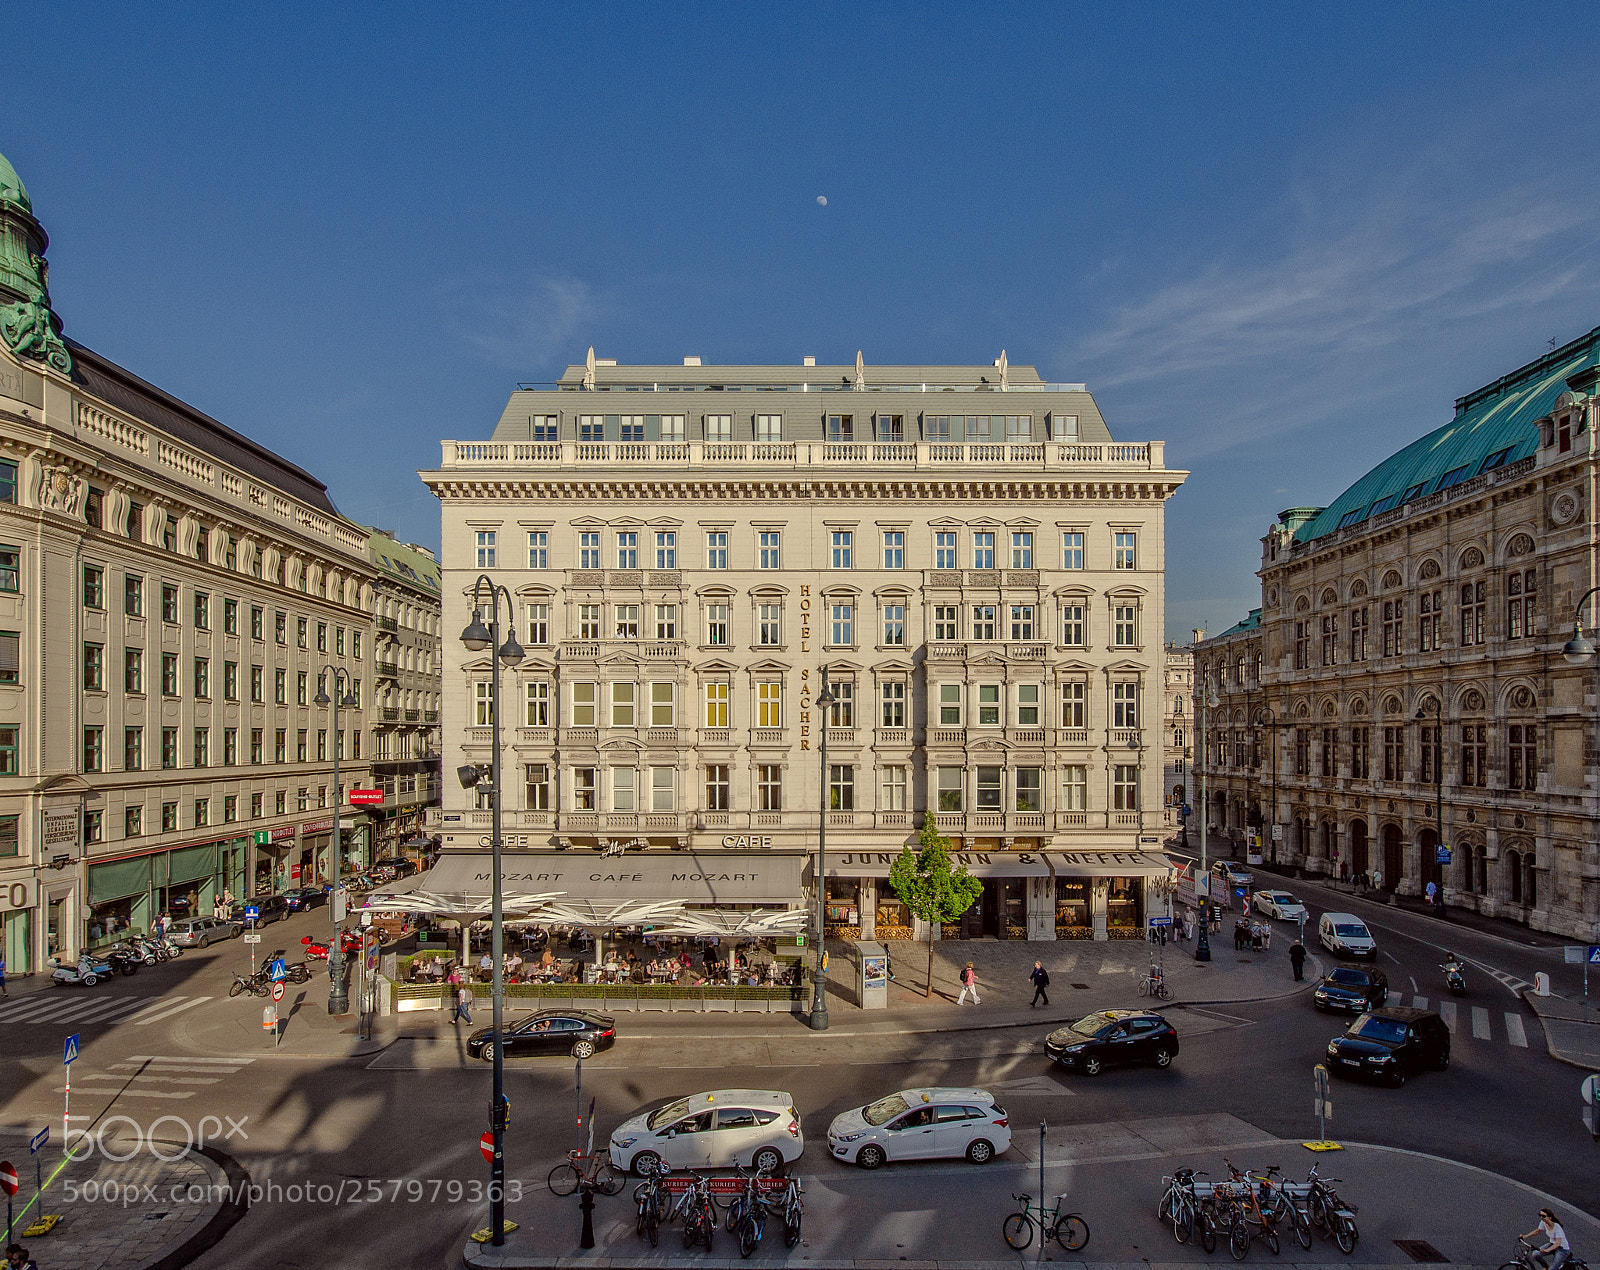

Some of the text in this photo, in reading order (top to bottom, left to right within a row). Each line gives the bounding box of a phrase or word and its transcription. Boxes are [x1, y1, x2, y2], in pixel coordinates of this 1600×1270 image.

[800, 584, 811, 751] HOTEL SACHER
[478, 834, 529, 848] CFE
[600, 838, 638, 858] Mozart
[721, 835, 774, 849] CAFE
[1018, 853, 1039, 865] &
[1062, 853, 1145, 865] NEFFE
[588, 872, 644, 882] CAFÉ
[671, 873, 760, 882] MOZART
